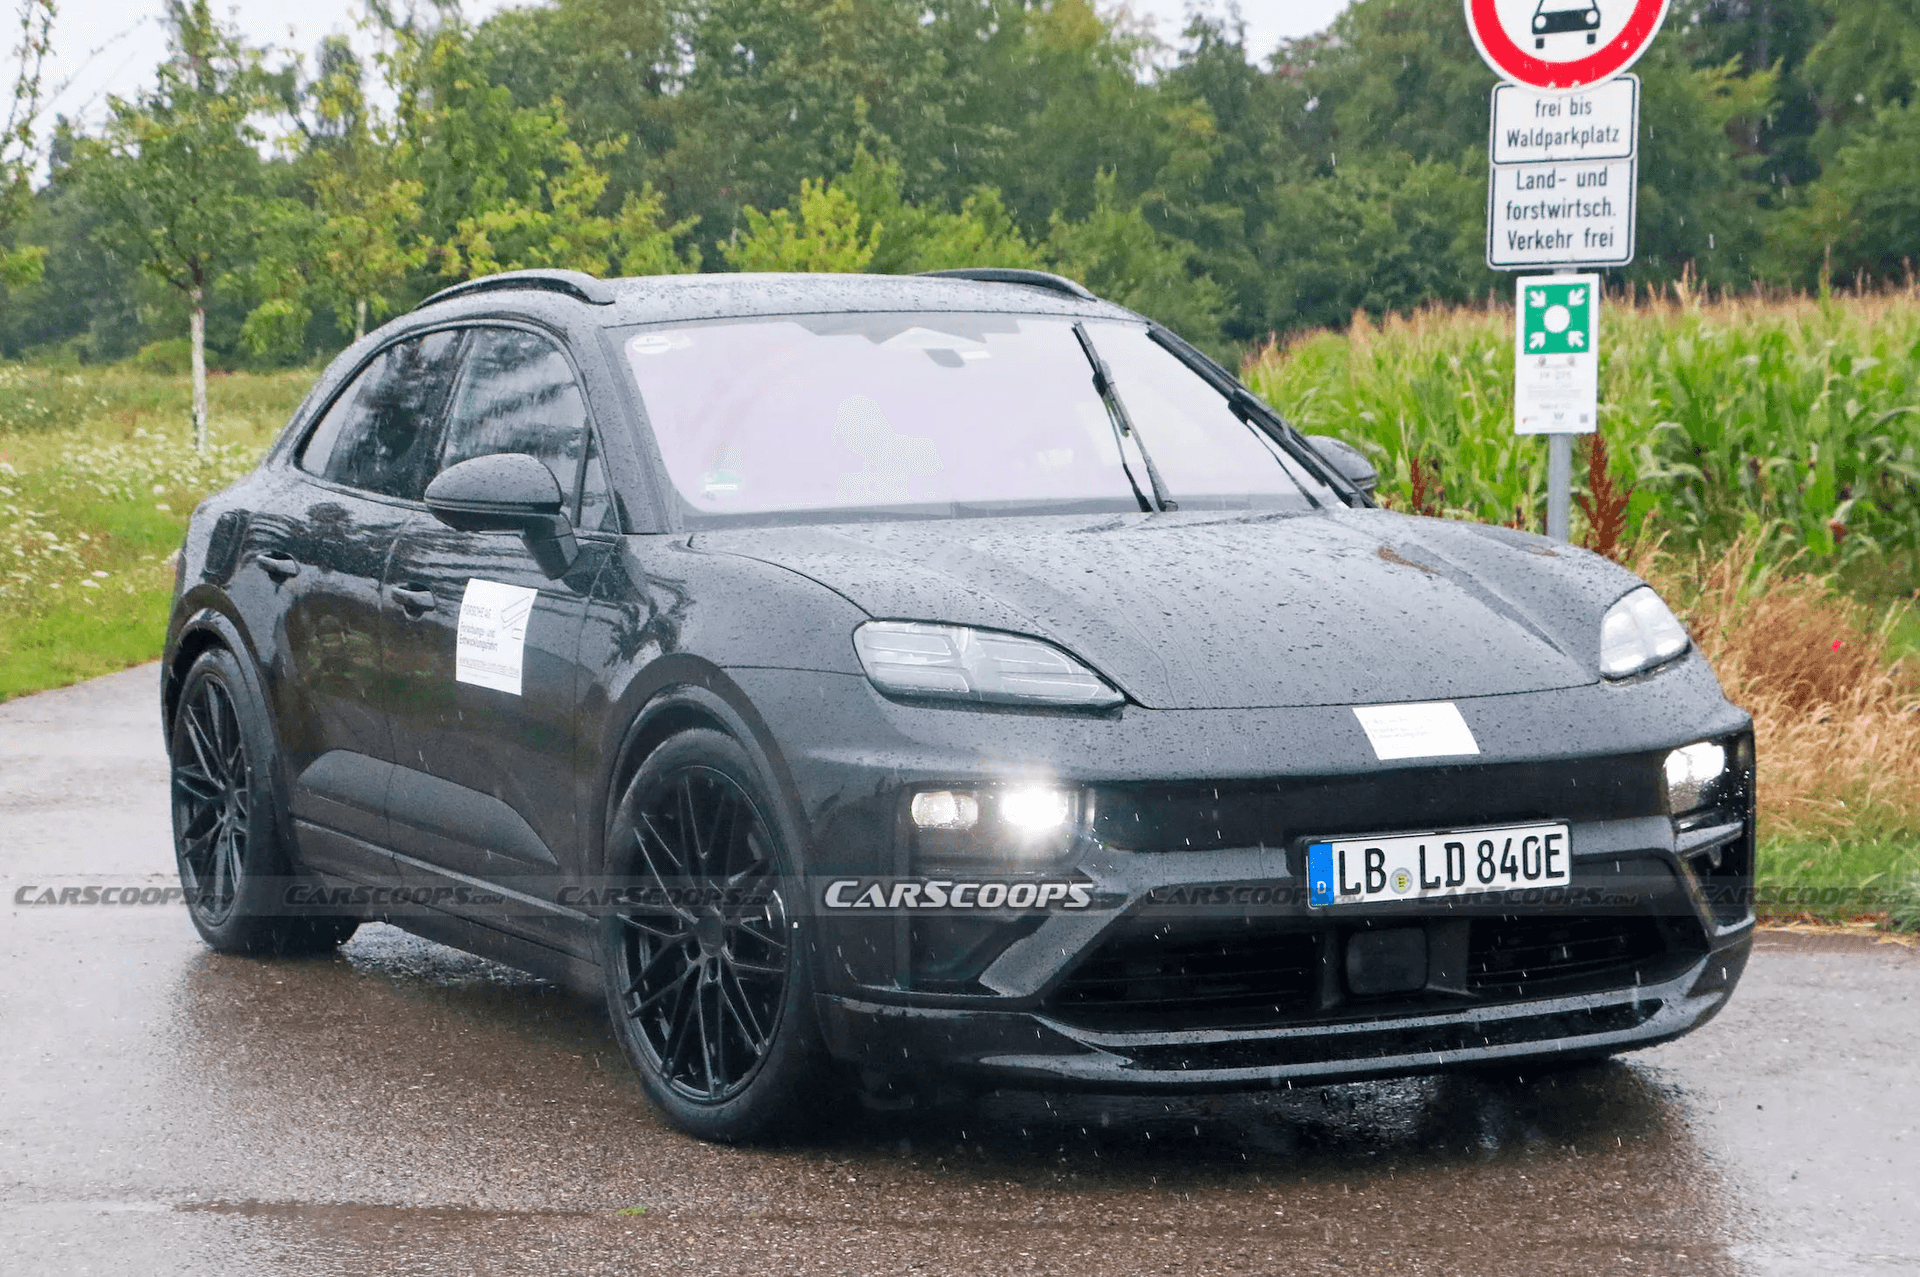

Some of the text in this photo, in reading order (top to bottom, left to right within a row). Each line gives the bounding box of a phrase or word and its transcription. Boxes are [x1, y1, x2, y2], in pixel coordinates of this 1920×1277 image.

[1535, 96, 1592, 118] frei bis
[1507, 125, 1620, 151] Waldparkplatz
[1516, 165, 1608, 190] Land- und
[1506, 196, 1617, 220] forstwirtsch.
[1507, 226, 1614, 251] Verkehr frei
[1338, 833, 1565, 896] LB LD 840E
[1316, 880, 1327, 895] D
